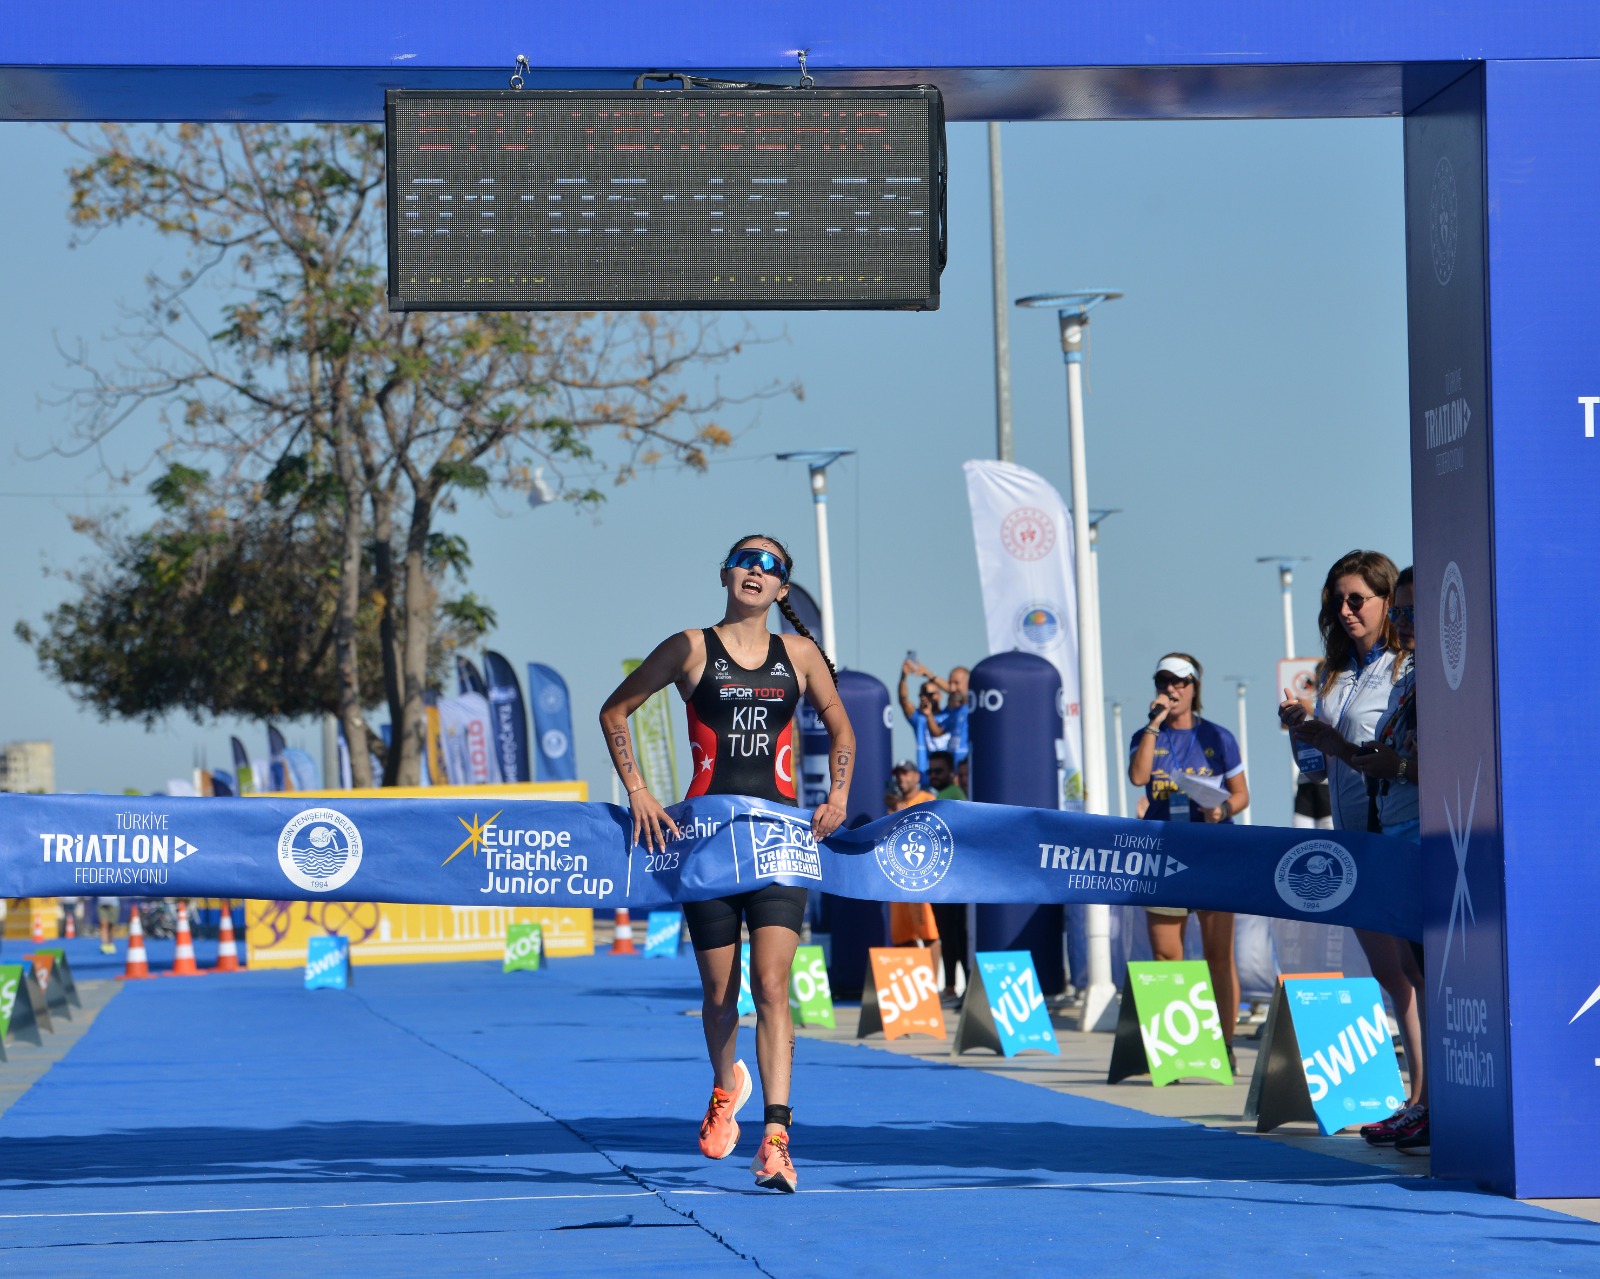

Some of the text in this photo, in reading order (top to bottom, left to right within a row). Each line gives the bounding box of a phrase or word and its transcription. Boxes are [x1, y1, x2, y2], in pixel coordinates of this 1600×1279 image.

[732, 706, 768, 730] KIR
[728, 733, 769, 757] TUR
[115, 811, 170, 830] TÜRKİYE
[482, 824, 571, 850] Europe
[1113, 833, 1165, 850] TÜRKİYE
[480, 848, 588, 872] Triathlon
[644, 852, 680, 873] 2023
[758, 848, 817, 864] TRIATHLON
[75, 867, 168, 885] FEDERASYONU
[480, 871, 614, 900] Junior Cup
[1068, 874, 1157, 894] FEDERASYONU
[877, 965, 939, 1024] SÜR
[990, 967, 1044, 1037] YÜZ
[1141, 981, 1223, 1069] KOŞ
[1445, 986, 1487, 1041] Europe
[1302, 1002, 1392, 1102] SWIM
